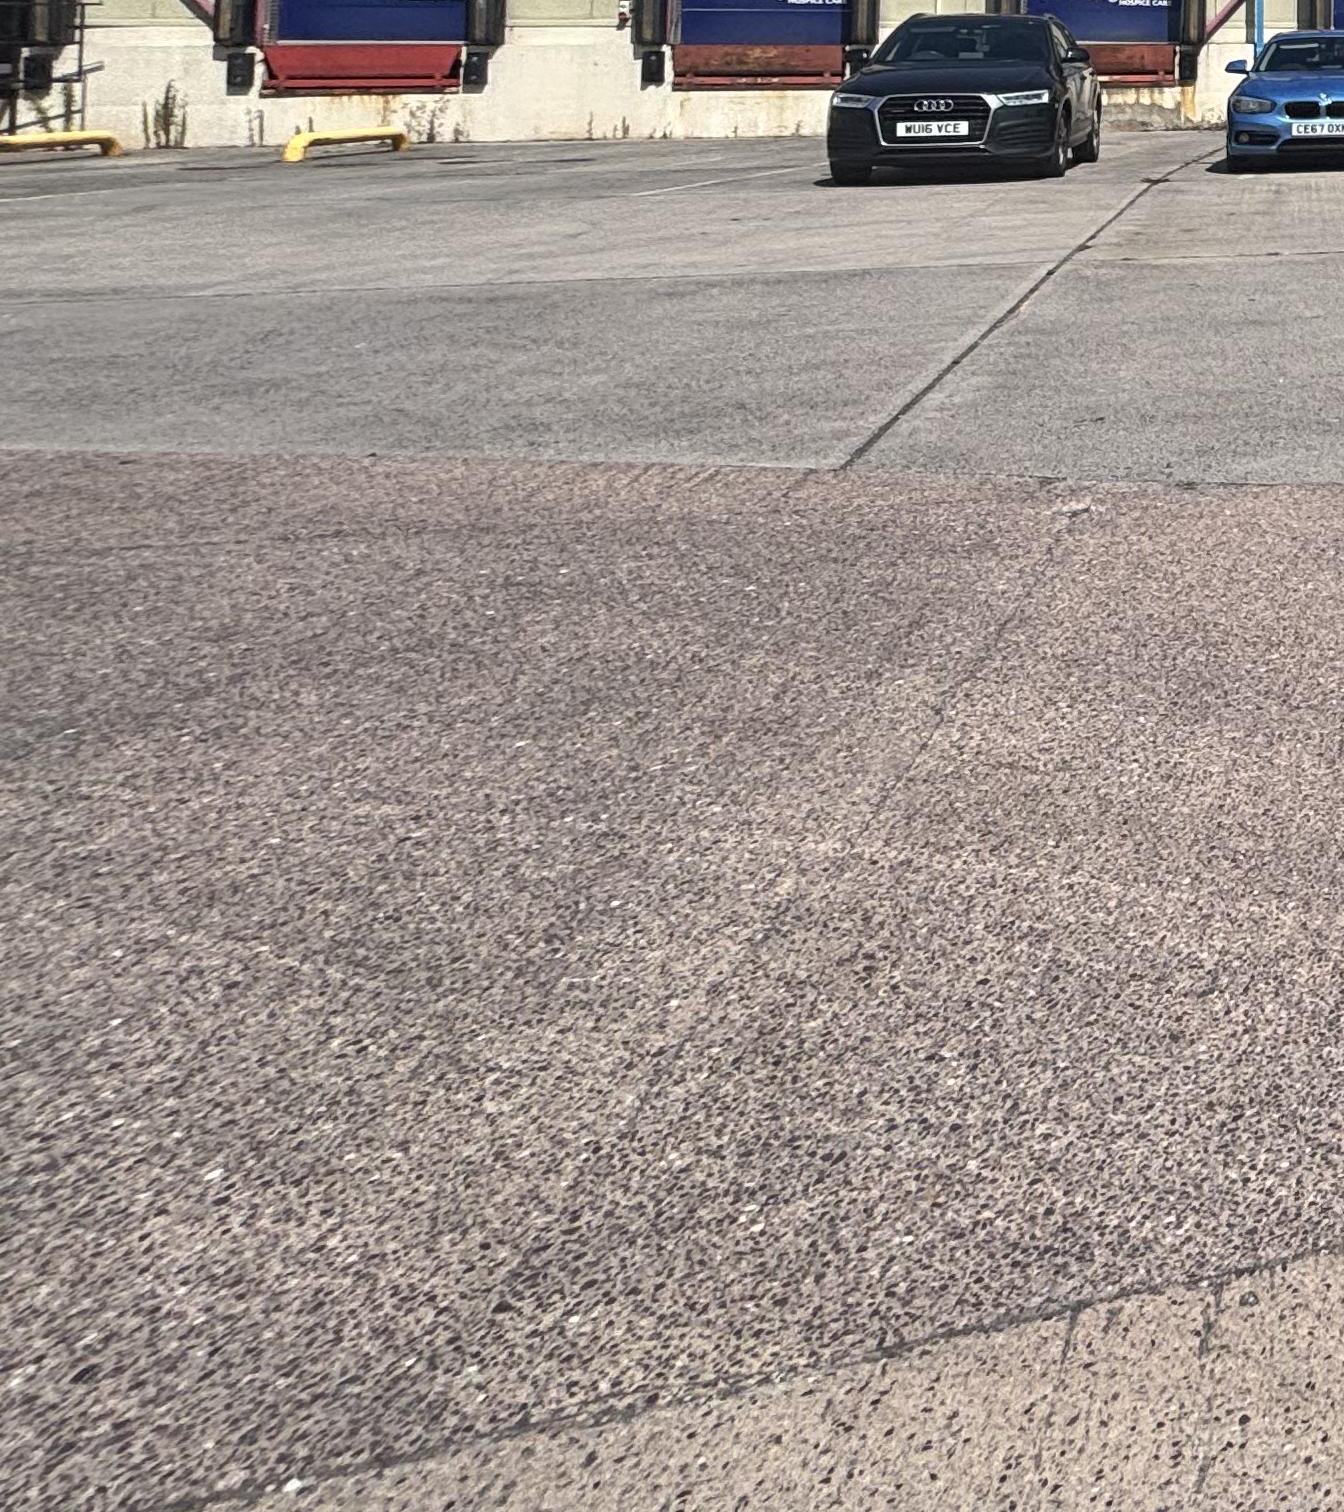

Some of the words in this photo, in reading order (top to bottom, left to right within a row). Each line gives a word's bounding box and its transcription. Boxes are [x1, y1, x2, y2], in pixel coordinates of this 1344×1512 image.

[905, 123, 933, 134] WU16
[937, 123, 961, 134] VCE
[1296, 123, 1325, 134] CE67
